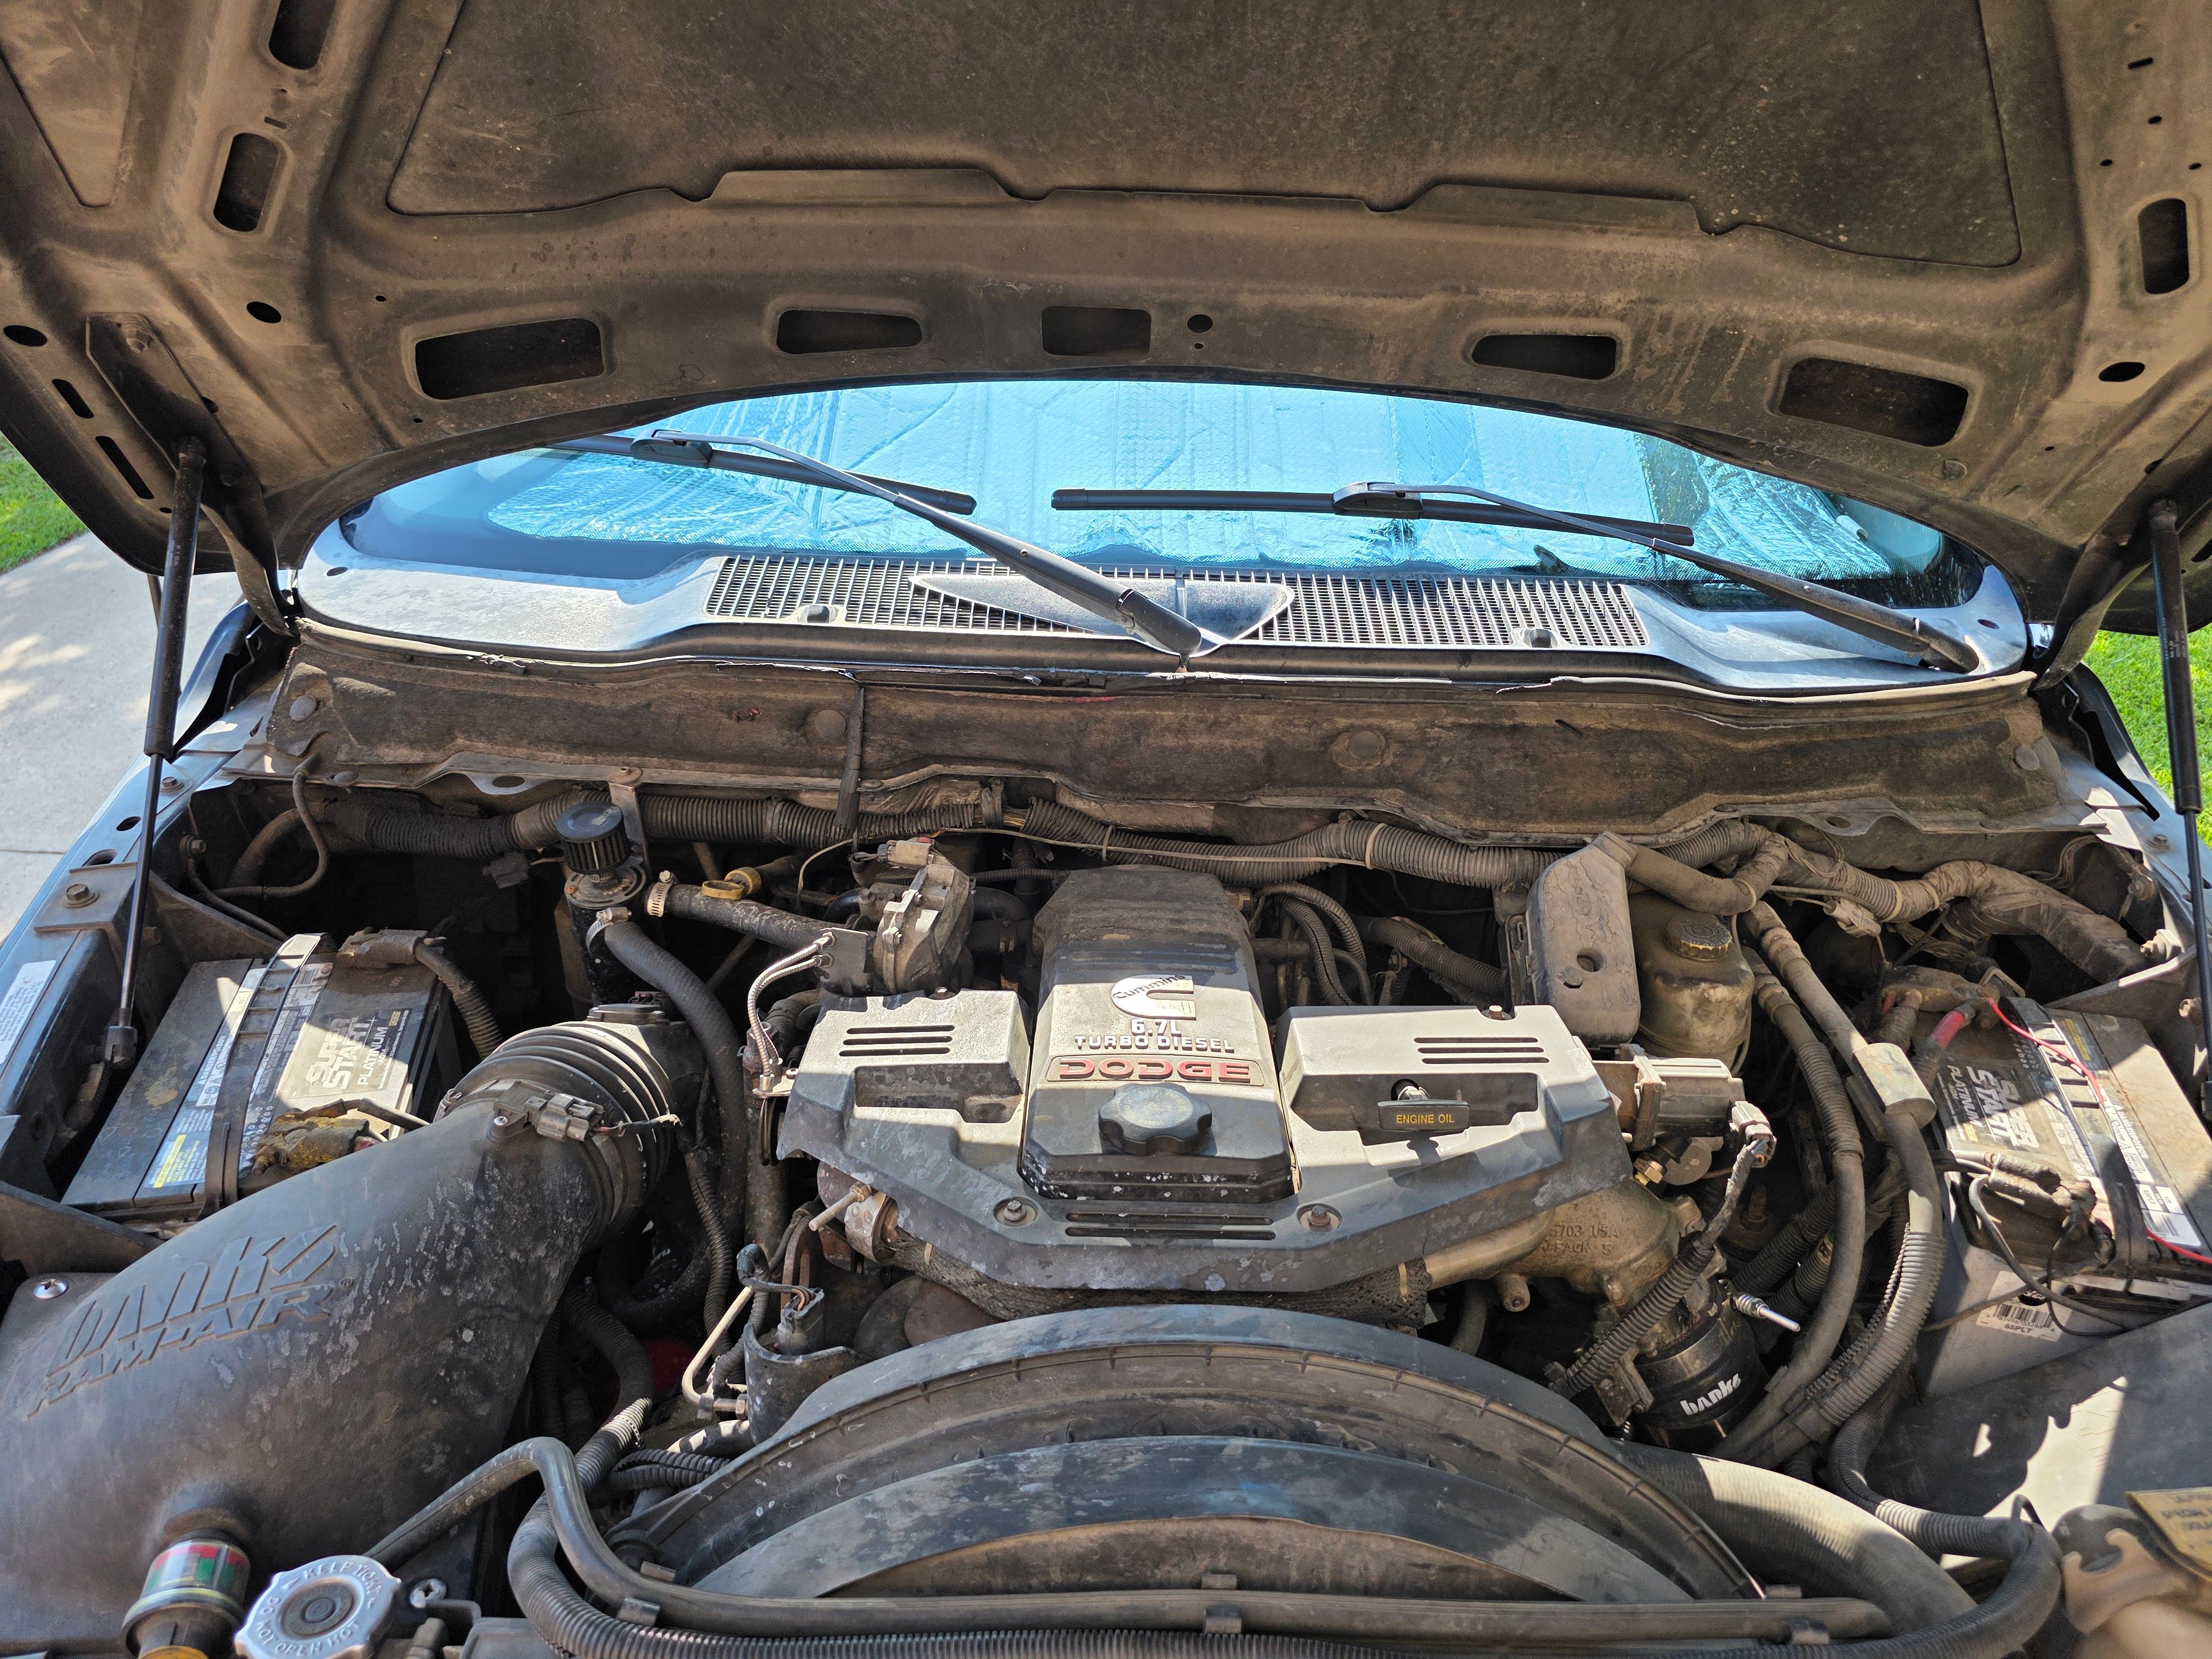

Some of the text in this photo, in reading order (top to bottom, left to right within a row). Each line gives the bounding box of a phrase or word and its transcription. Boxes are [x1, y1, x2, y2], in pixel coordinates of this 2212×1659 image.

[1112, 974, 1186, 1000] Cummins
[1131, 1018, 1182, 1037] 6.7L
[306, 1018, 352, 1082] SUPER
[322, 1016, 370, 1089] START
[357, 1026, 389, 1086] PLATINUM
[1074, 1035, 1235, 1053] TURBO DIESEL
[1059, 1057, 1251, 1083] DODGE
[1947, 1065, 1983, 1128] PLATINUM
[1966, 1066, 2021, 1147] START
[1396, 1113, 1455, 1124] ENGINE OIL
[1998, 1079, 2039, 1149] SUPER
[1590, 1223, 1619, 1239] USA
[2004, 1323, 2033, 1334] 65PLT
[274, 1641, 324, 1656] OPEN
[327, 1619, 361, 1647] HOT
